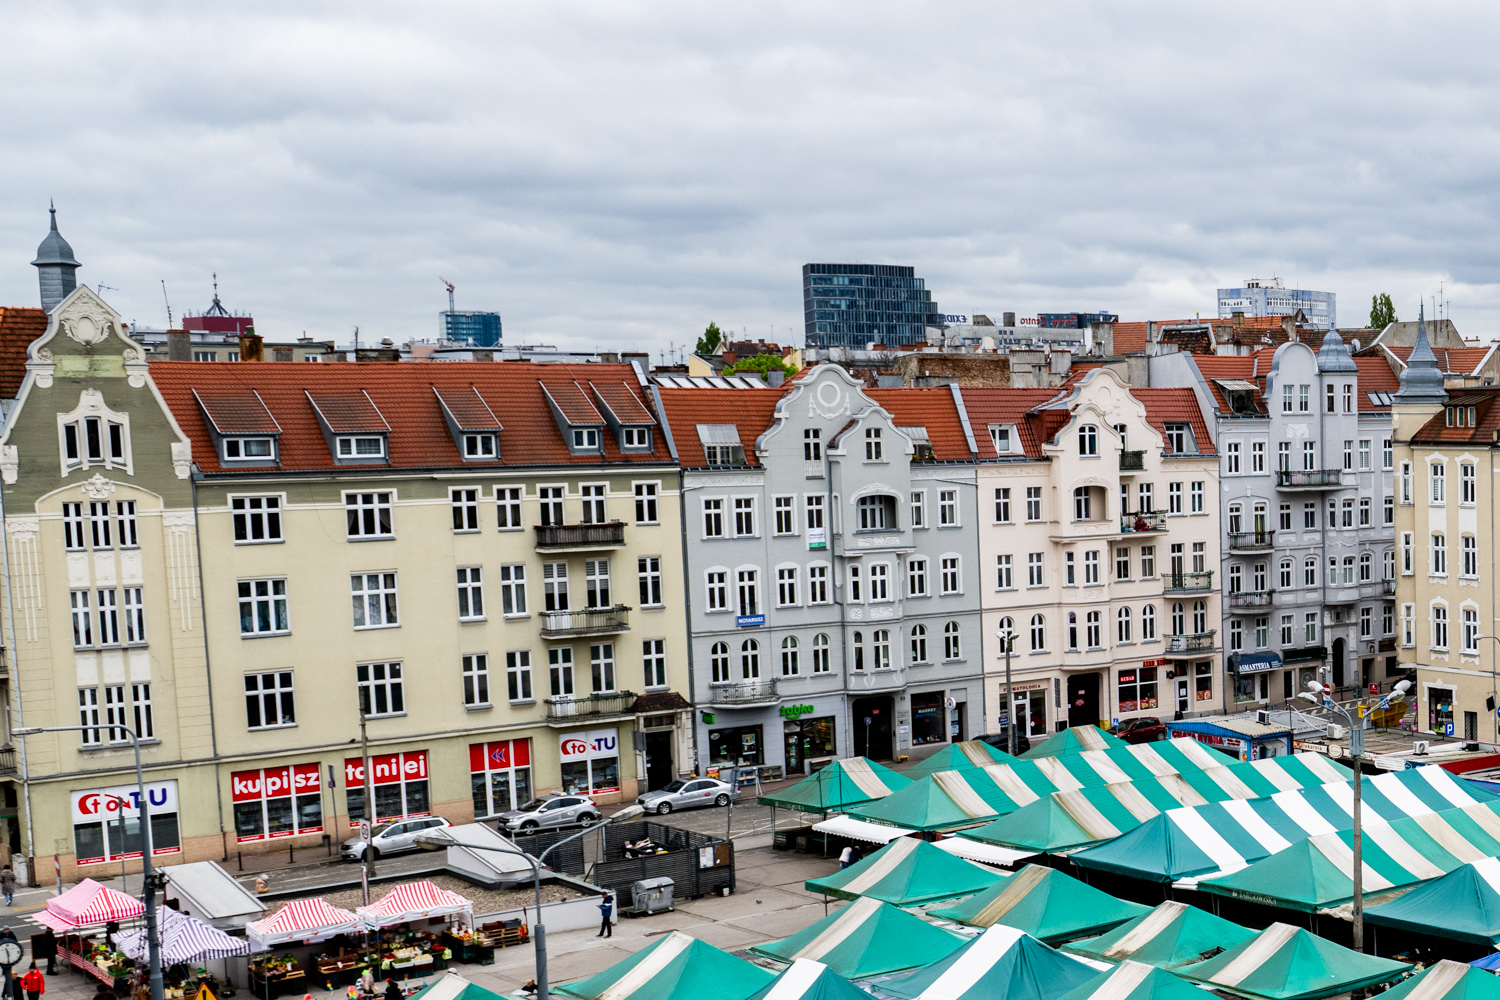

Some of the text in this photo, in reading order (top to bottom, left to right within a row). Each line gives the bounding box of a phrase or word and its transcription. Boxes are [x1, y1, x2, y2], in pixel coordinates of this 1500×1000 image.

[738, 616, 764, 625] NOTARIUSZ
[780, 703, 815, 717] żabka
[1447, 723, 1453, 735] P
[1198, 733, 1224, 745] RYBNA
[233, 771, 320, 795] kupisz
